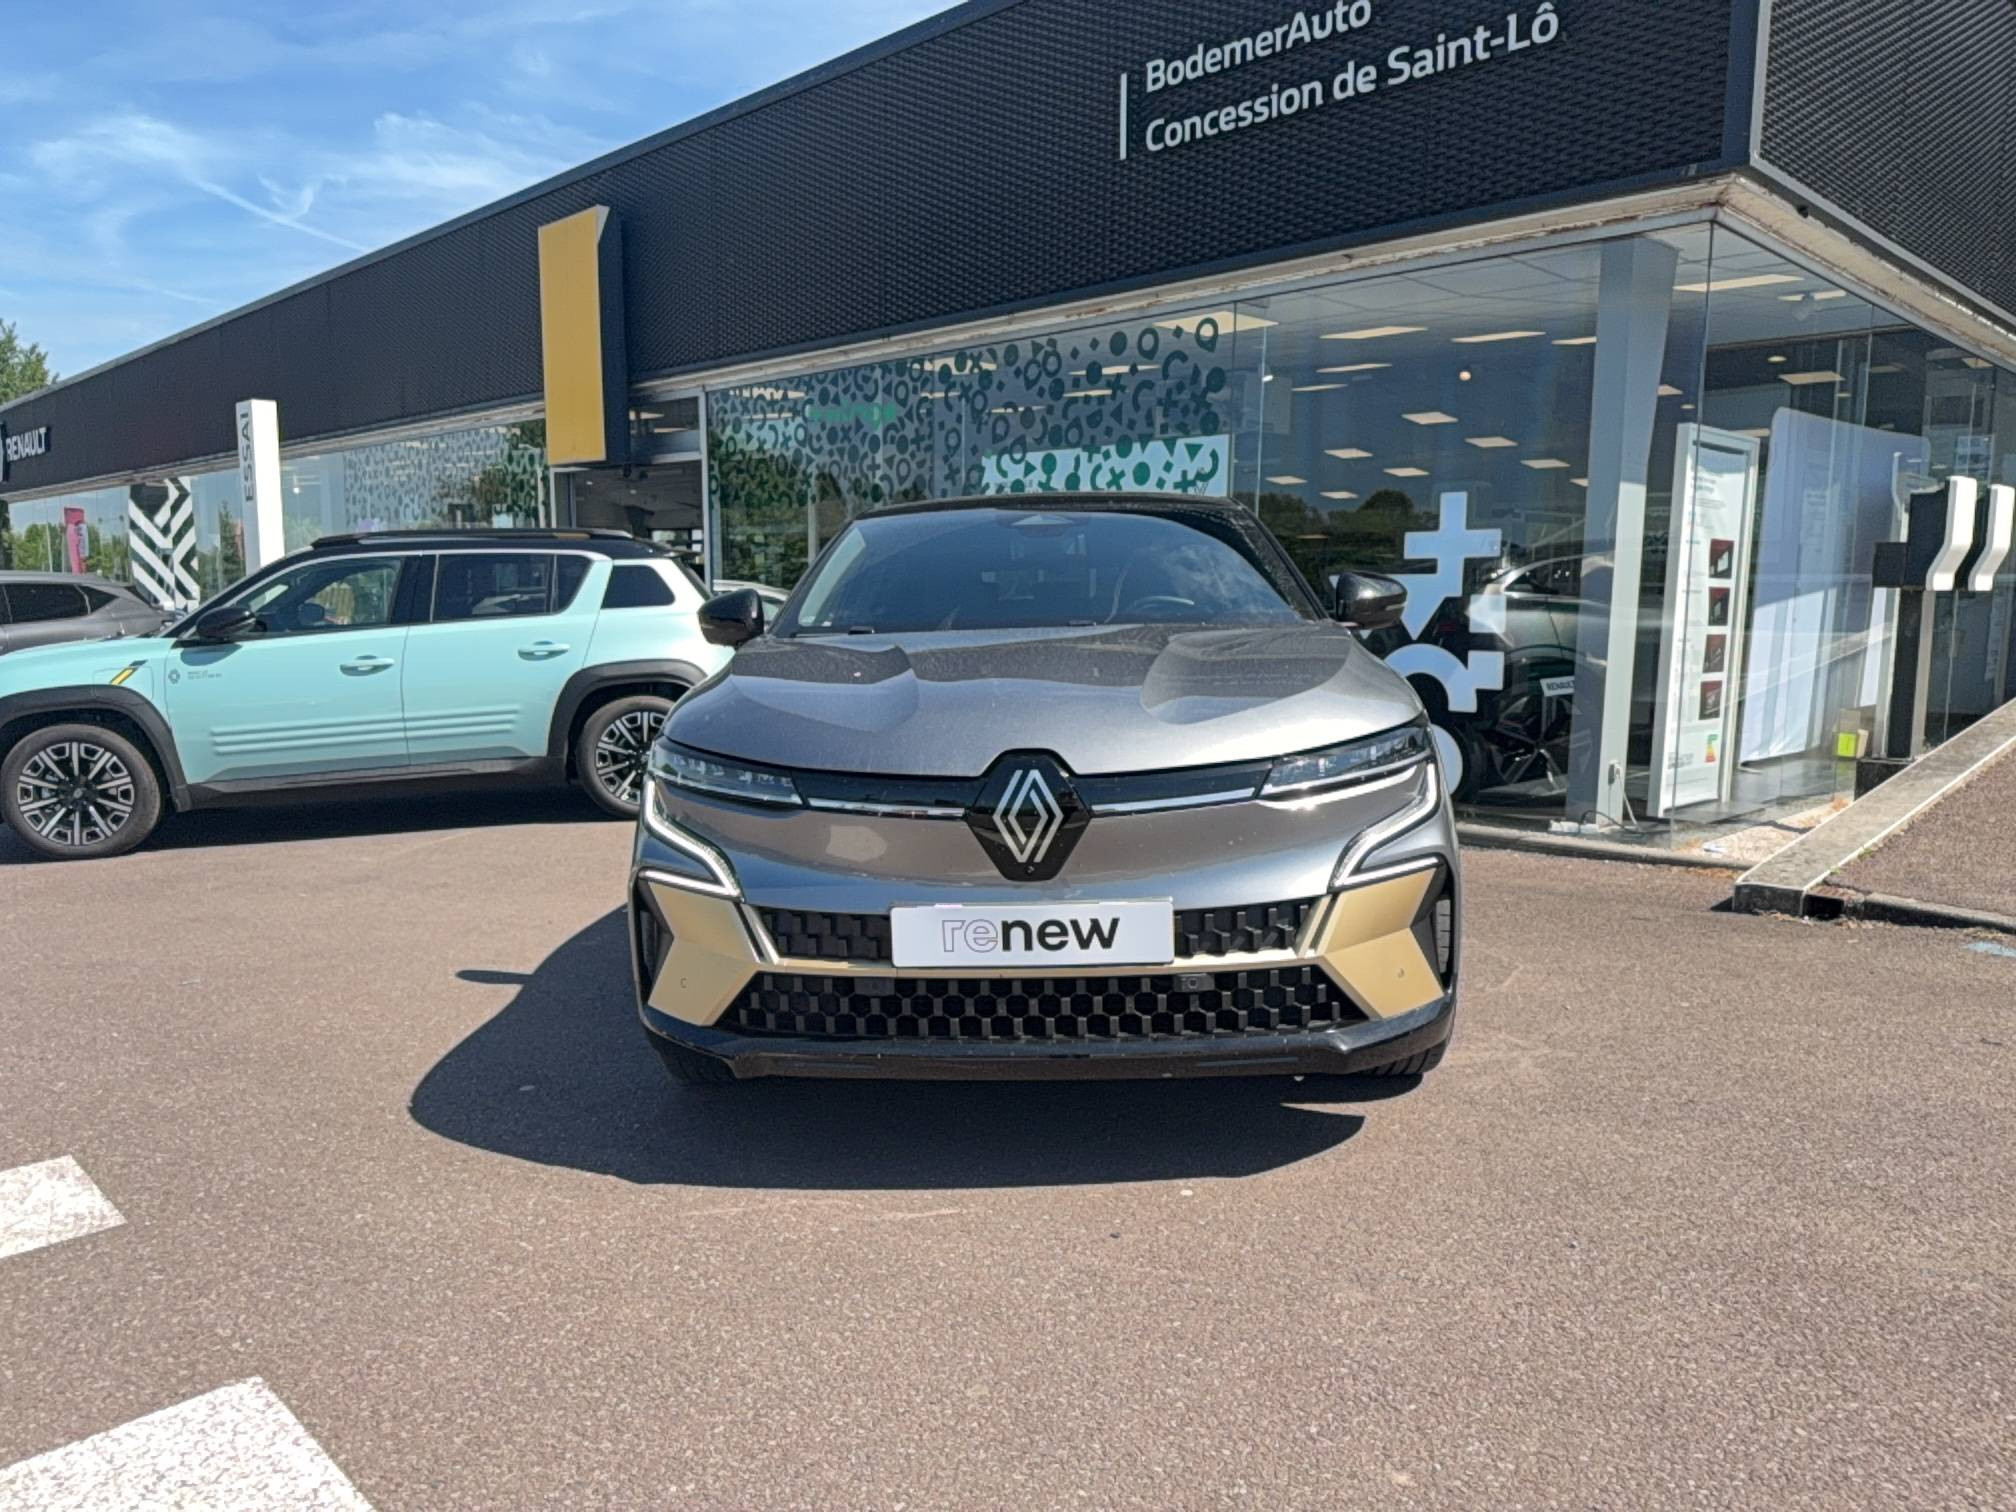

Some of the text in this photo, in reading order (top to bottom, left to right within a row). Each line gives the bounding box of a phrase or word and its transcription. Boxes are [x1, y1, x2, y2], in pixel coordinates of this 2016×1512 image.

[1145, 2, 1559, 151] Concession de Saint-Lô
[1146, 0, 1371, 93] BodemerAuto
[6, 427, 46, 462] RENAULT
[240, 413, 254, 501] ESSAI
[942, 917, 1120, 953] renew
